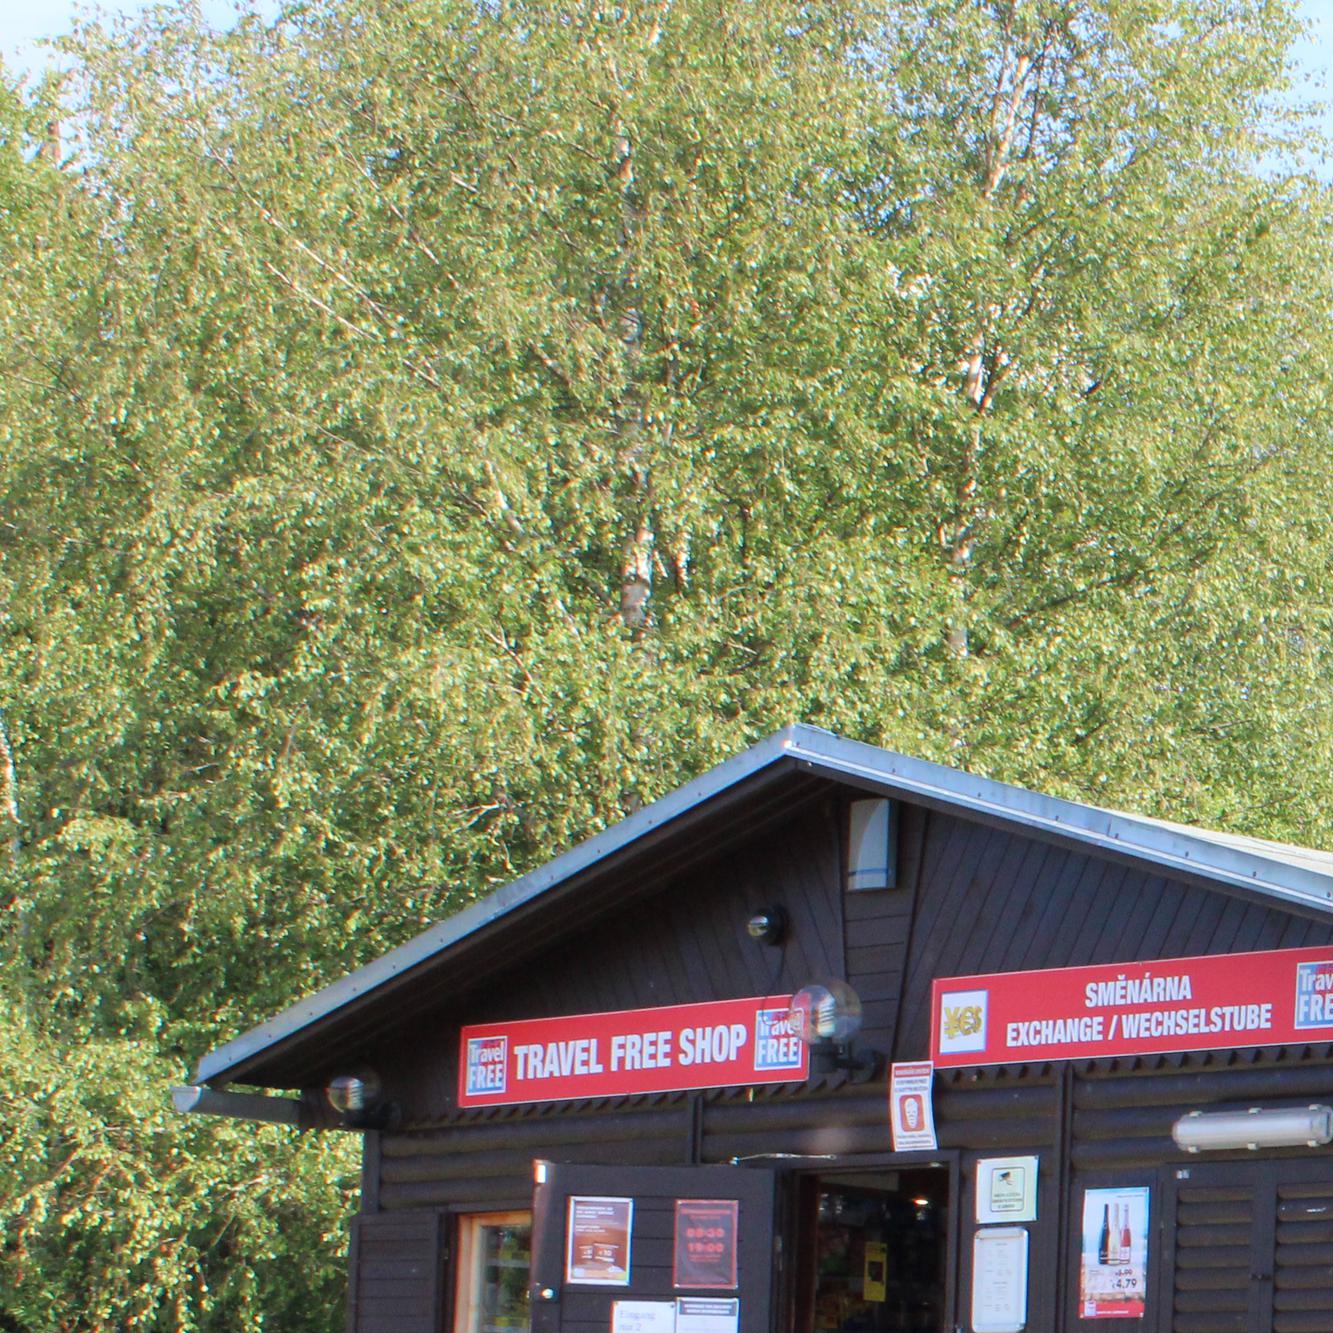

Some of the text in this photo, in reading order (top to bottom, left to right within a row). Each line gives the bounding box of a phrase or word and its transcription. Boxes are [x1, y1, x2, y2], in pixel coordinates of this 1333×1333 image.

[1085, 972, 1192, 1008] SMĚNÁRNA
[1006, 1003, 1273, 1047] EXCHANGE / WECHSELSTUBE
[469, 1040, 504, 1063] Travel
[513, 1024, 747, 1080] TRAVEL FREE SHOP
[758, 1037, 799, 1063] FREE
[469, 1064, 503, 1090] FREE
